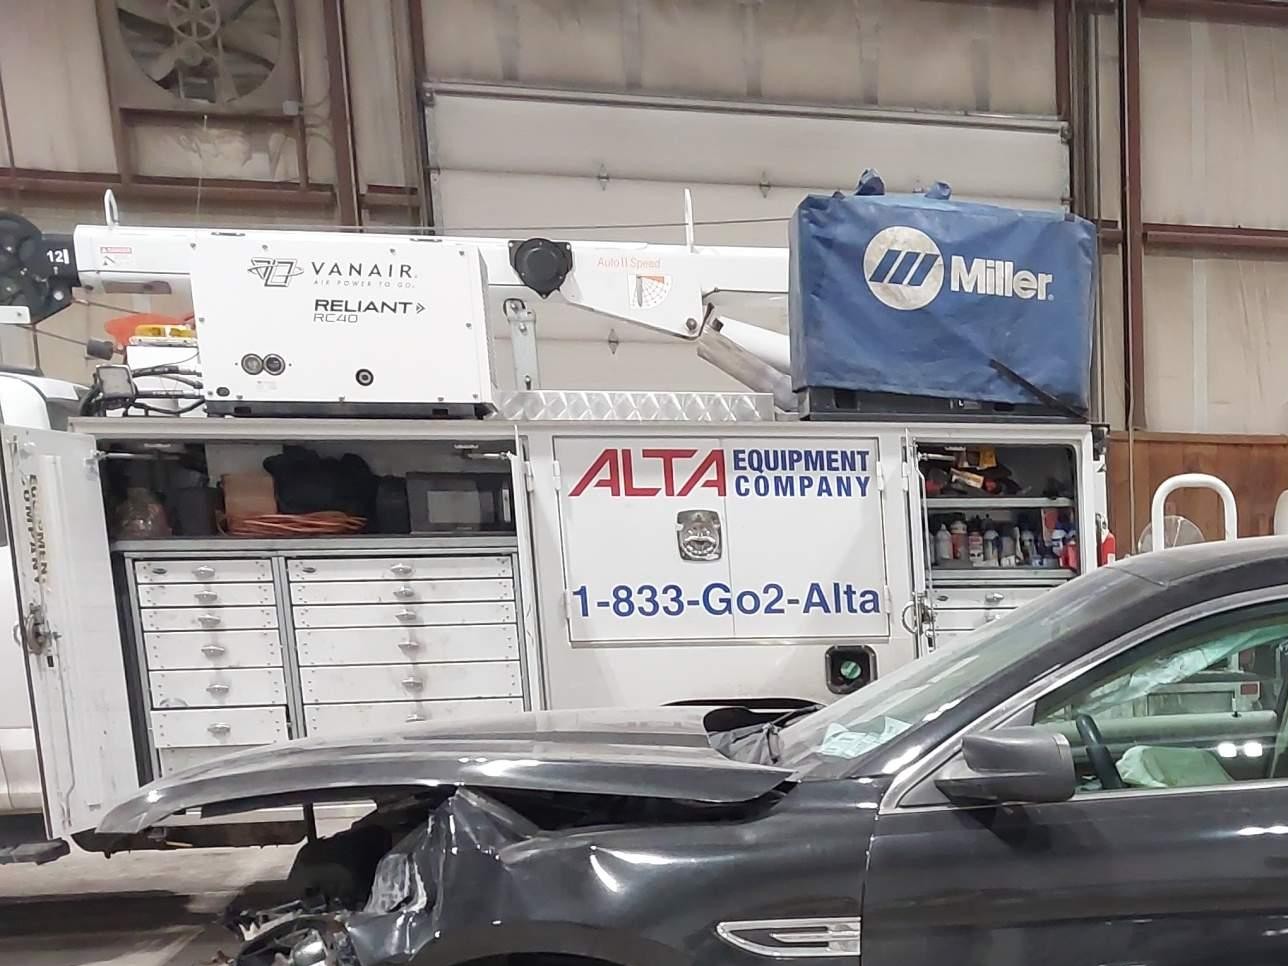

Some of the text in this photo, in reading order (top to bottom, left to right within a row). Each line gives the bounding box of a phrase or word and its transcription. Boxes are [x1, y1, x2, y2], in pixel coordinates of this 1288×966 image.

[311, 261, 413, 278] VANAIR
[950, 255, 1054, 301] Miller
[313, 313, 358, 323] RC40
[314, 299, 413, 314] RELIANT
[568, 448, 870, 497] ALTA EQUIPMENT
[735, 475, 871, 498] COMPANY
[572, 582, 881, 617] 1-833-Go2-Alta
